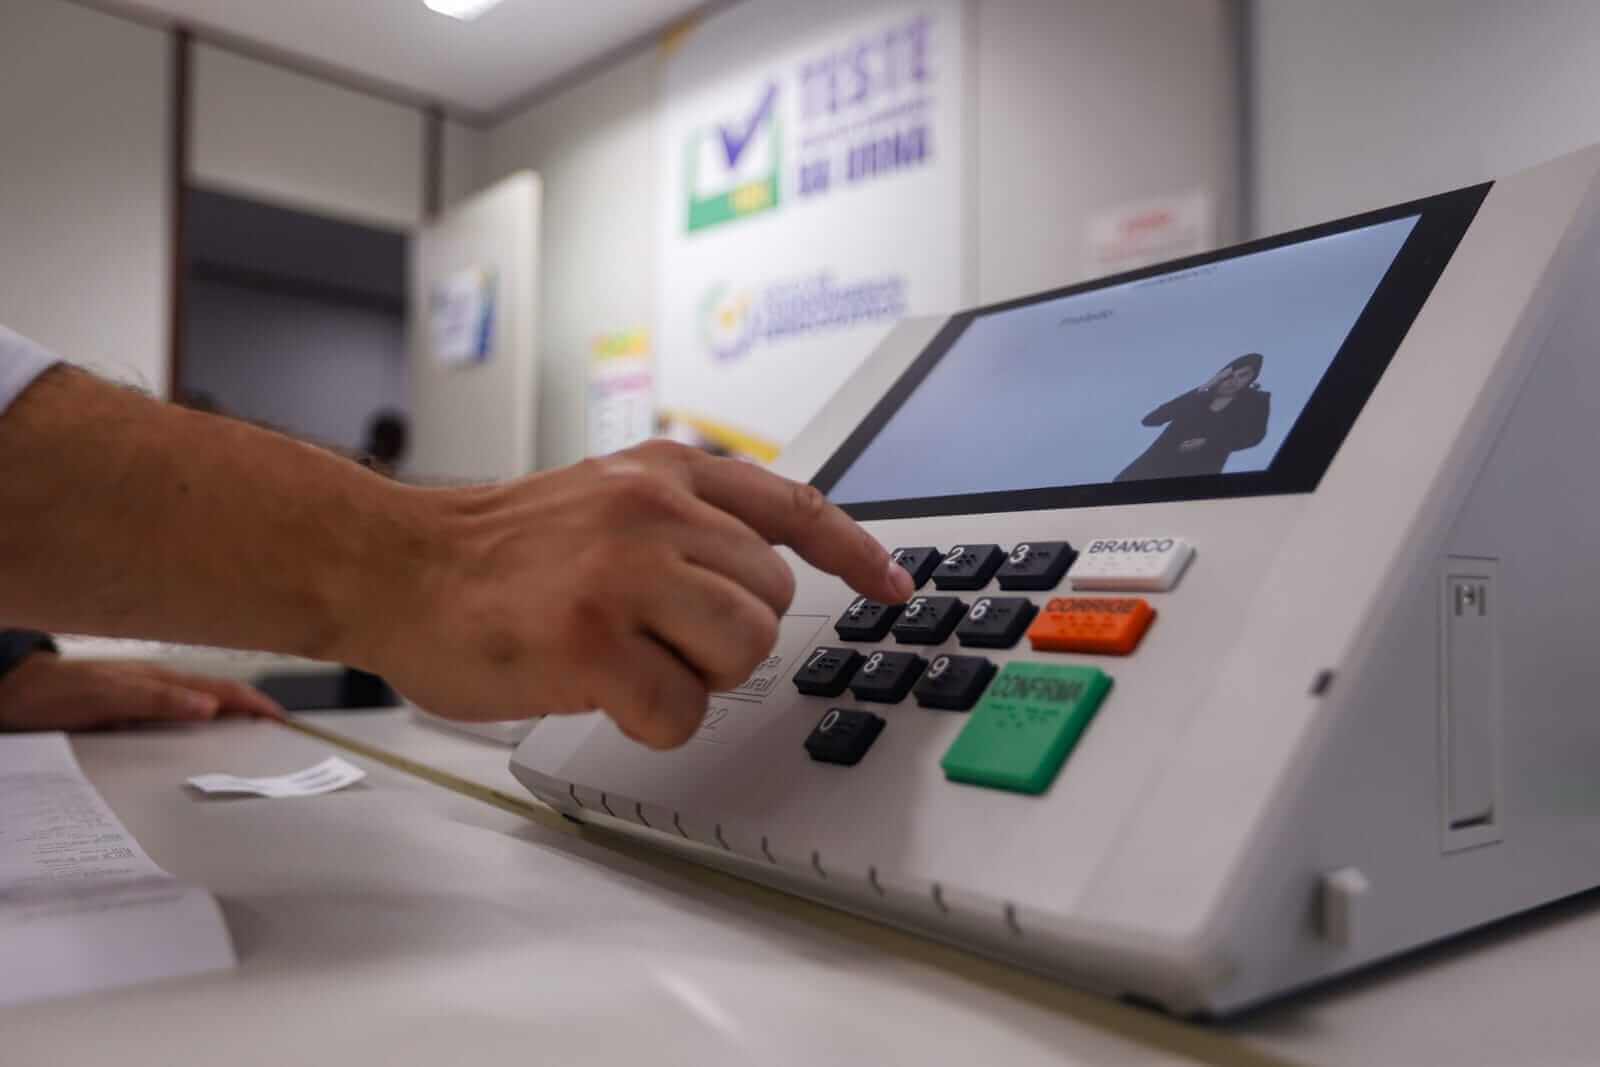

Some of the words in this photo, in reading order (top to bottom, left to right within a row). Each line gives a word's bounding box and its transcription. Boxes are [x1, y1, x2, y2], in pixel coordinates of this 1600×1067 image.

[943, 547, 966, 564] 2
[1010, 545, 1029, 563] 3
[1089, 540, 1173, 552] BRANCO
[849, 599, 866, 616] 4
[905, 598, 925, 617] 5
[970, 599, 991, 619] 6
[808, 649, 827, 667] 7
[864, 653, 884, 672] 8
[928, 657, 950, 677] 9
[991, 674, 1083, 702] CONFIRMA
[820, 710, 840, 731] 0
